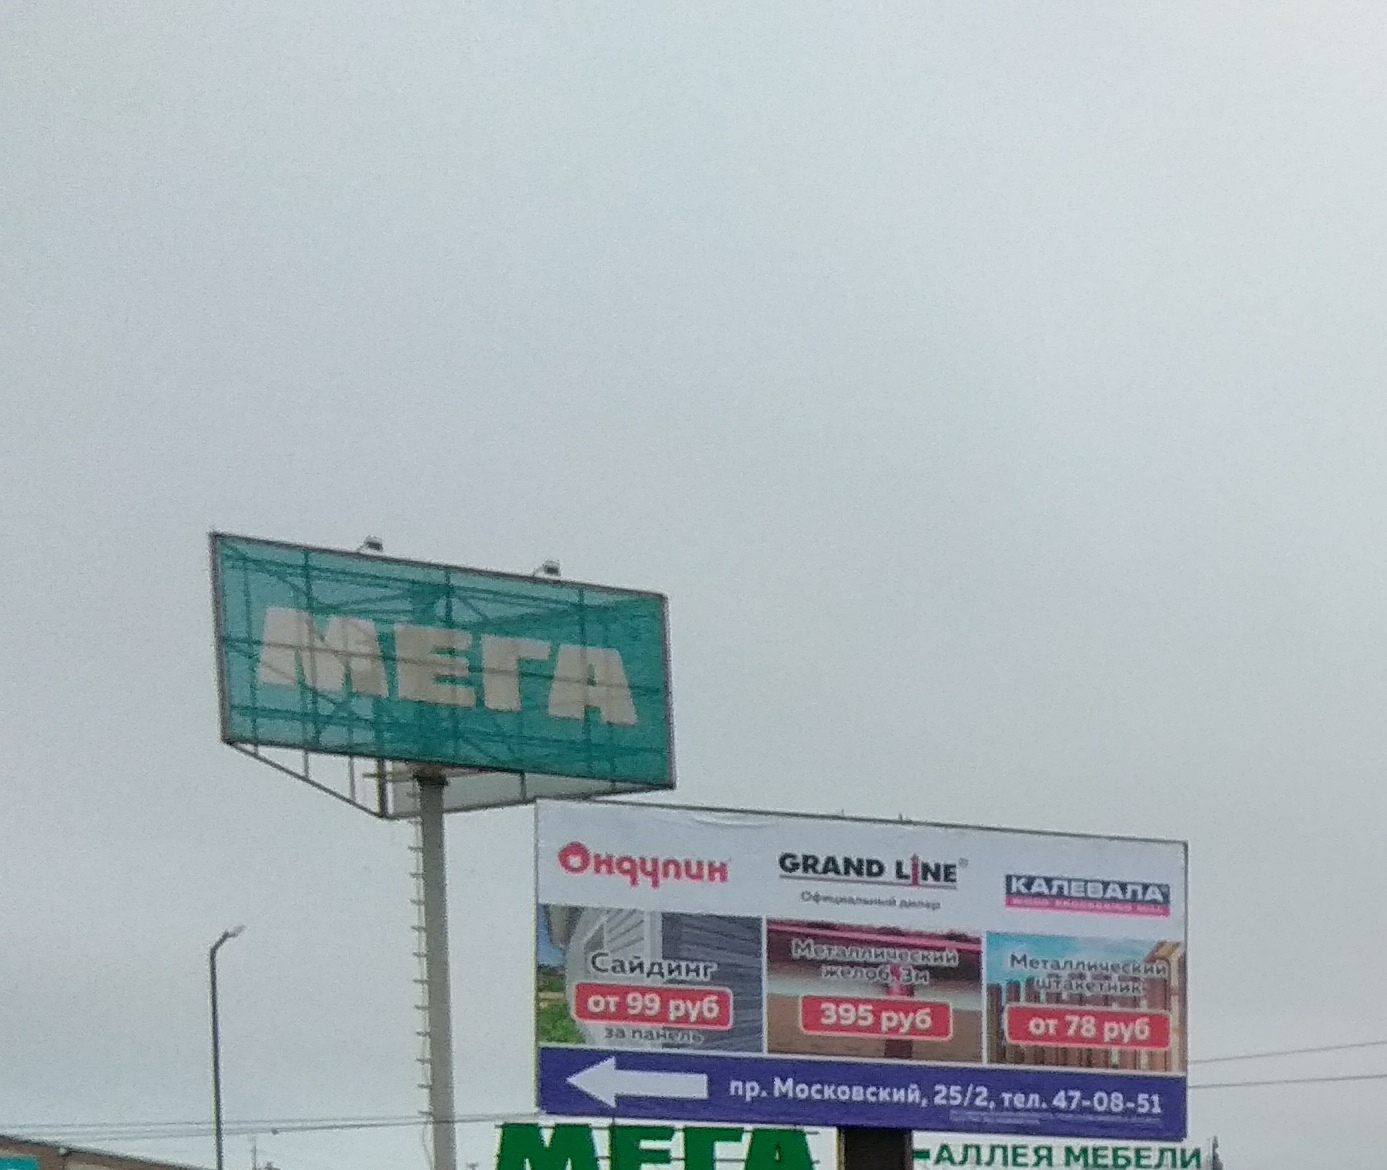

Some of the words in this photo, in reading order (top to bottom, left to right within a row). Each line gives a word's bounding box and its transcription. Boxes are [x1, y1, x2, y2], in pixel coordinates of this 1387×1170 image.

[256, 605, 638, 727] МЕГА
[558, 841, 728, 888] Ондулин
[779, 852, 885, 877] GRAND
[895, 853, 957, 887] LINE
[1010, 876, 1165, 903] КАЛЕВАЛА
[591, 952, 716, 979] Сайдинг
[792, 940, 958, 965] Металлический
[1010, 952, 1168, 976] Металлический
[1036, 977, 1143, 994] штакетник
[587, 994, 619, 1013] от
[626, 992, 661, 1016] 99
[669, 995, 720, 1022] руб
[820, 1002, 873, 1026] 395
[881, 1008, 932, 1034] руб
[605, 1027, 626, 1039] за
[632, 1029, 703, 1044] панель
[1028, 1016, 1058, 1036] от
[1065, 1015, 1096, 1038] 78
[1103, 1018, 1150, 1043] руб
[729, 1079, 767, 1101] пр.
[773, 1077, 928, 1107] Московский,
[934, 1083, 995, 1110] 25/2,
[1001, 1092, 1048, 1109] тел.
[1053, 1090, 1162, 1113] 47-08-51
[1063, 1145, 1202, 1170] МЕБЕЛИ
